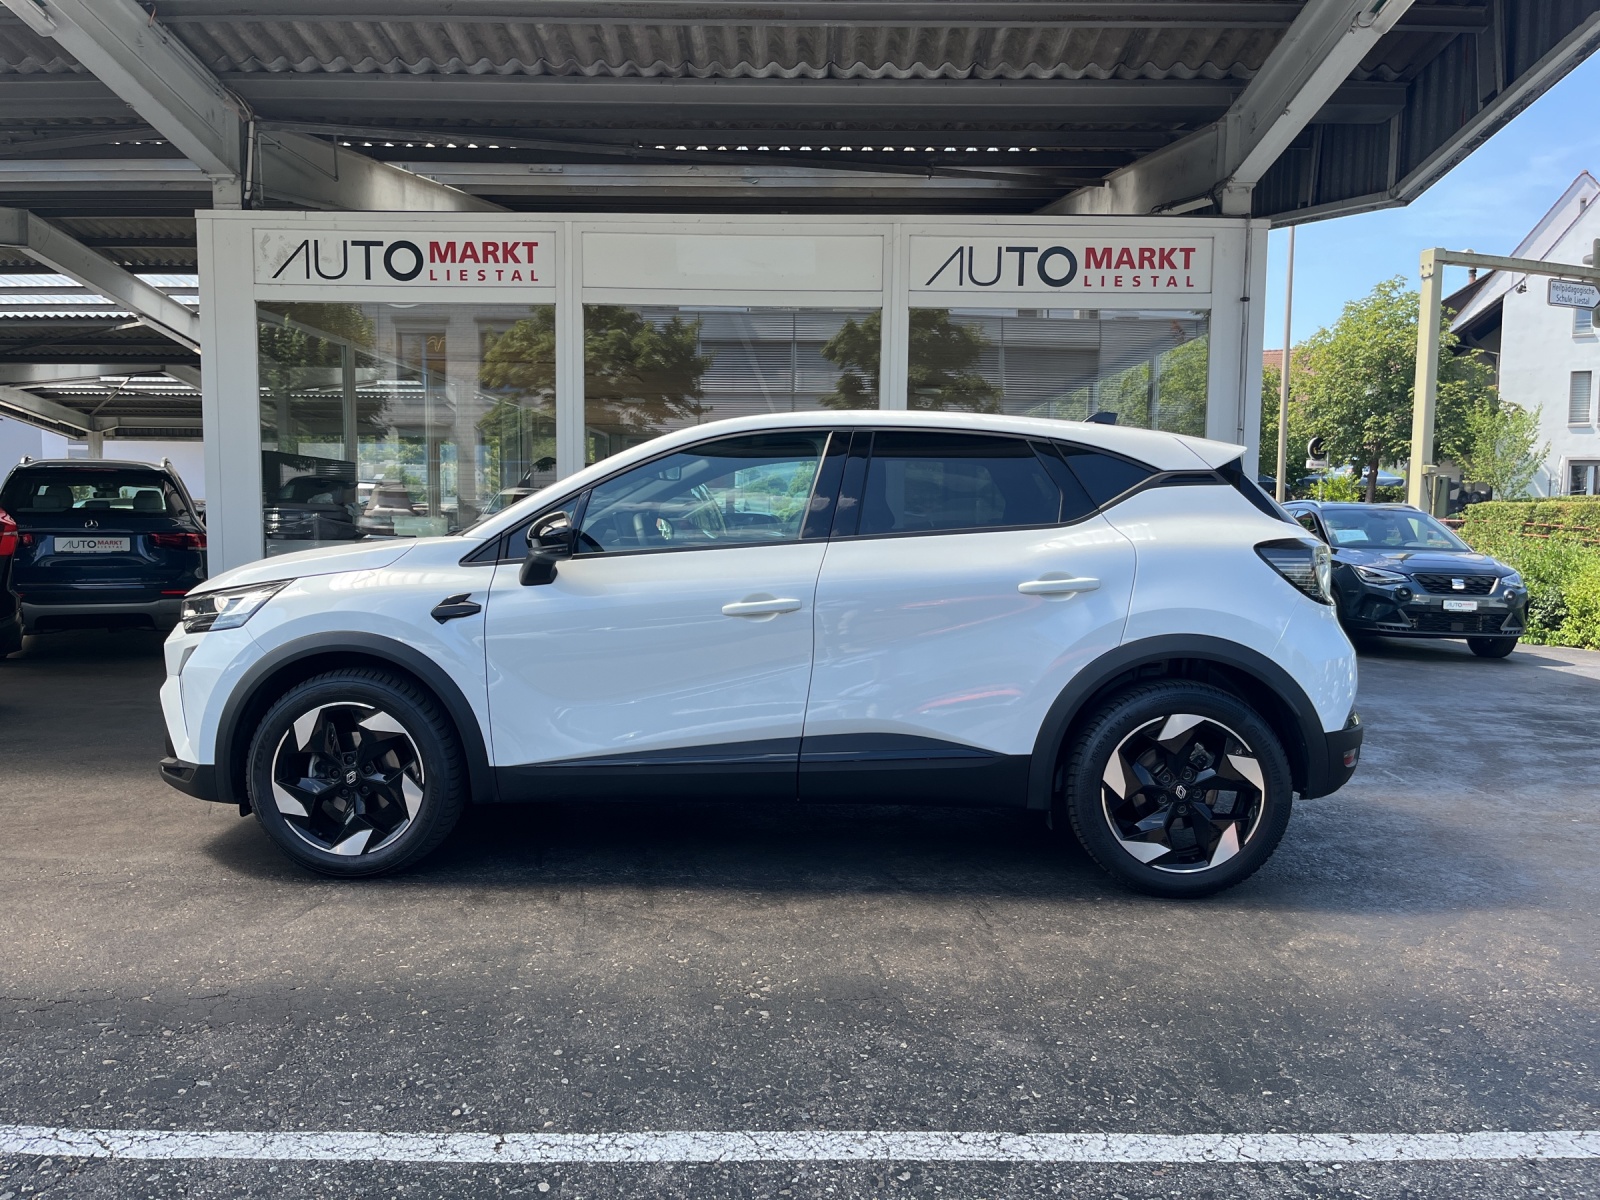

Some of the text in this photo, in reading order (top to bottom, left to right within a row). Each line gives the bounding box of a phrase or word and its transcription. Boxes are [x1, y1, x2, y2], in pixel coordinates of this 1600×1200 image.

[271, 239, 539, 281] AUTO MARKT
[925, 245, 1196, 288] AUTO MARKT
[429, 269, 539, 282] LIESTAL
[1084, 275, 1194, 288] LIESTAL
[1552, 283, 1595, 296] Heilpädagogische
[1556, 295, 1590, 305] Schule Liestal
[62, 540, 97, 549] AUTO
